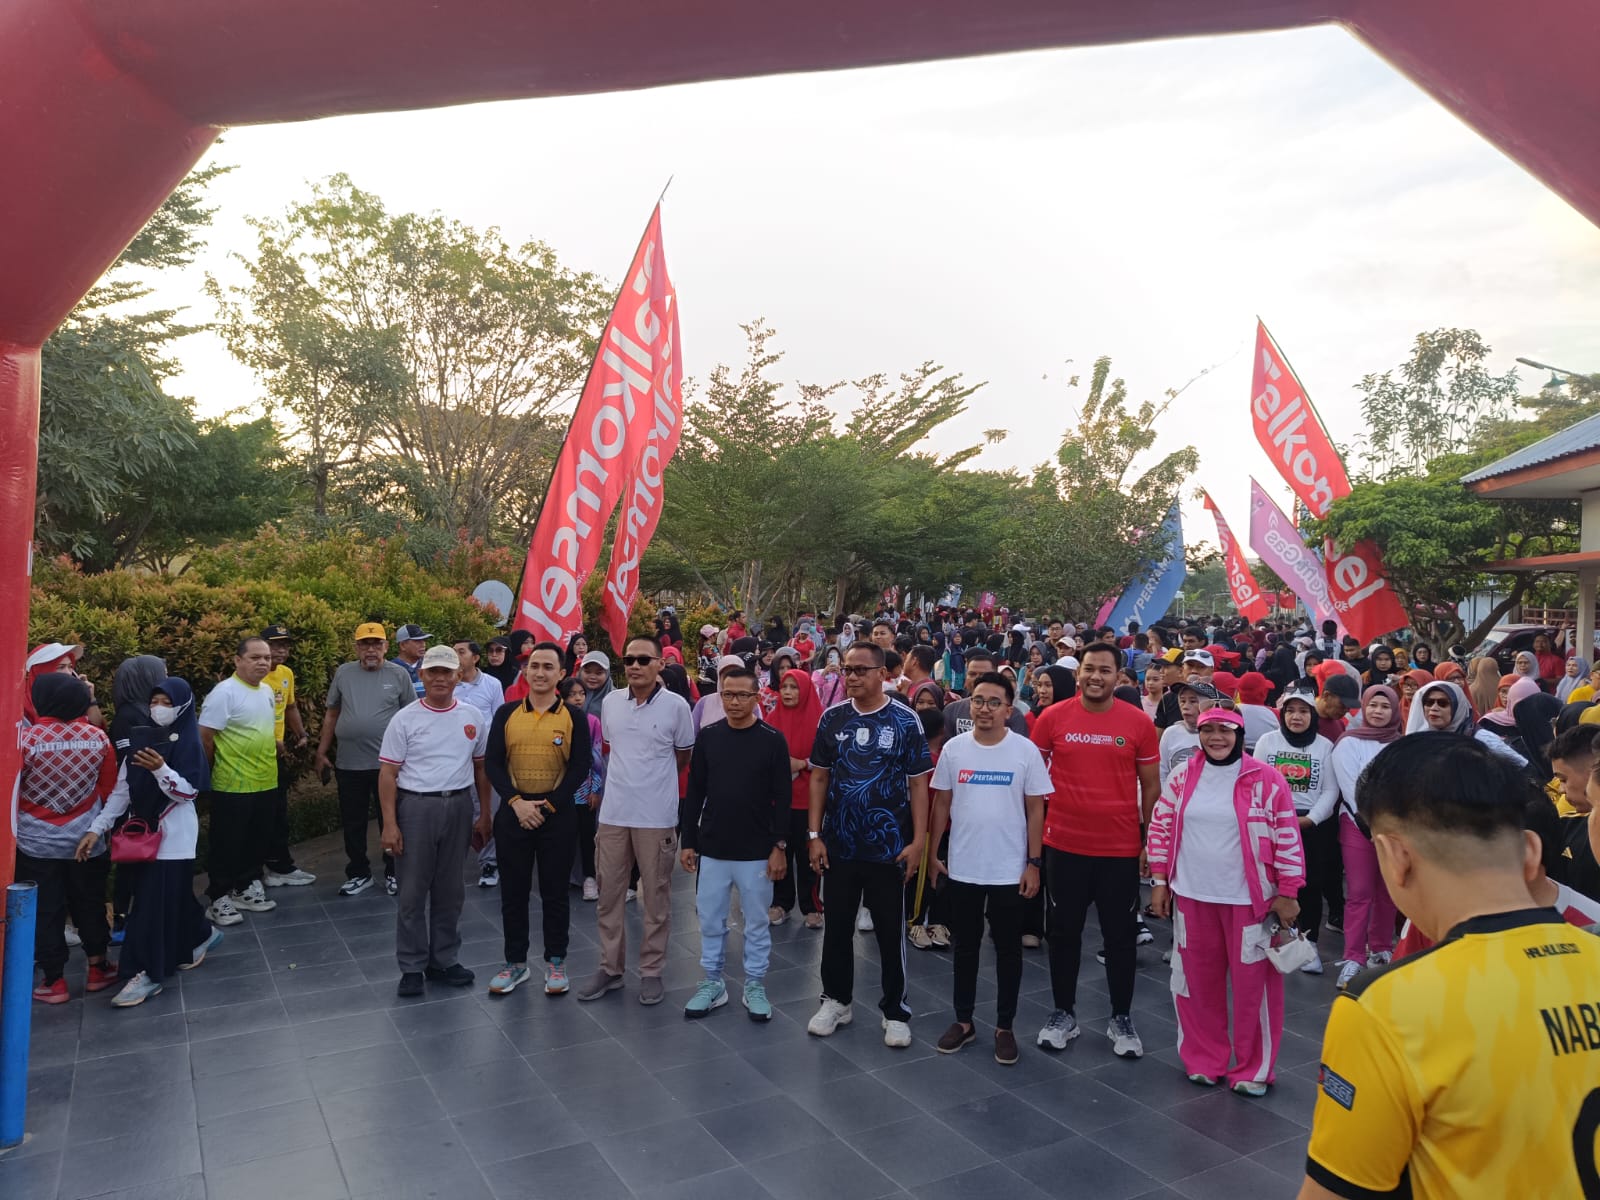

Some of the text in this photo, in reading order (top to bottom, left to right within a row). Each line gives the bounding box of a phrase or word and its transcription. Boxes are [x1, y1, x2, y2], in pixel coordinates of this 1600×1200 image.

[1278, 751, 1311, 761] GUCCI
[1309, 759, 1319, 790] GUCCI
[1540, 1001, 1600, 1057] NAB
